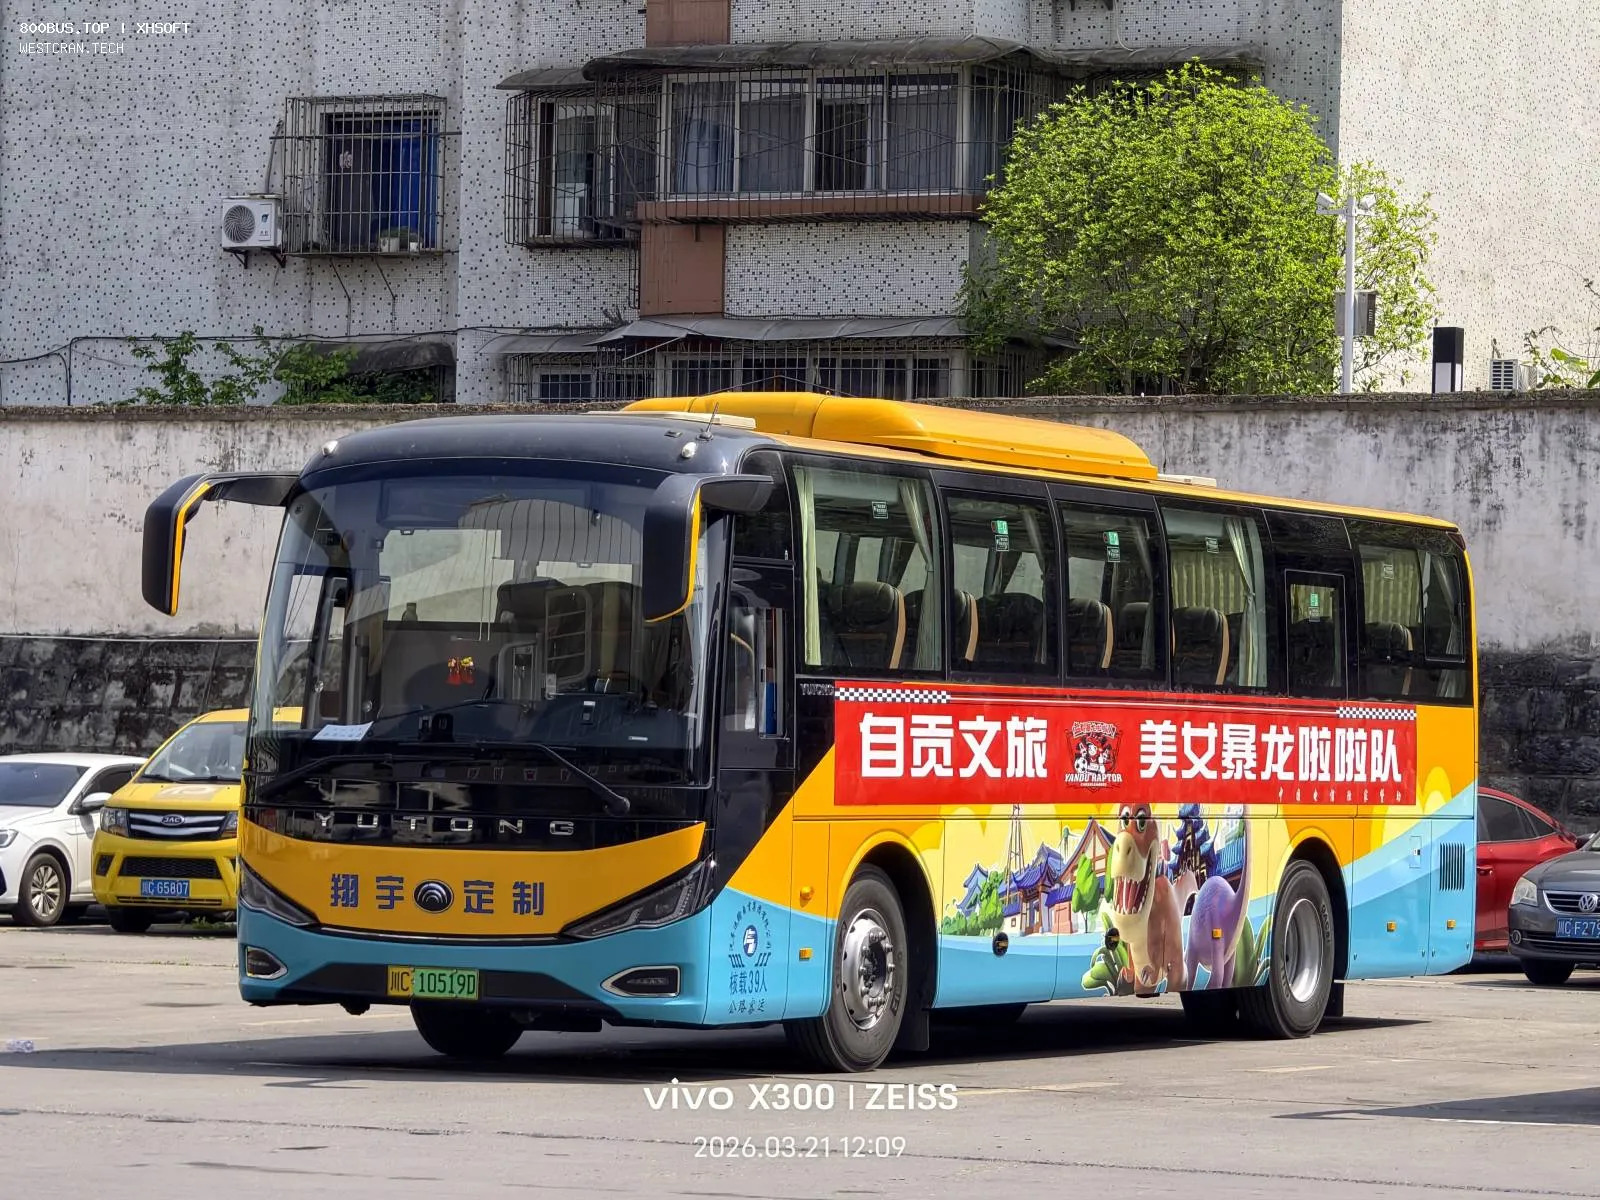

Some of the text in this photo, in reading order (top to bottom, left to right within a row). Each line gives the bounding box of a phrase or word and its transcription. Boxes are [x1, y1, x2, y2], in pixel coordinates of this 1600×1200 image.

[859, 712, 1048, 778] 自贡文旅
[1139, 719, 1402, 783] 美女暴龙啦啦队
[1065, 773, 1123, 783] YANDU RAPTOR
[315, 812, 575, 836] YUTONG
